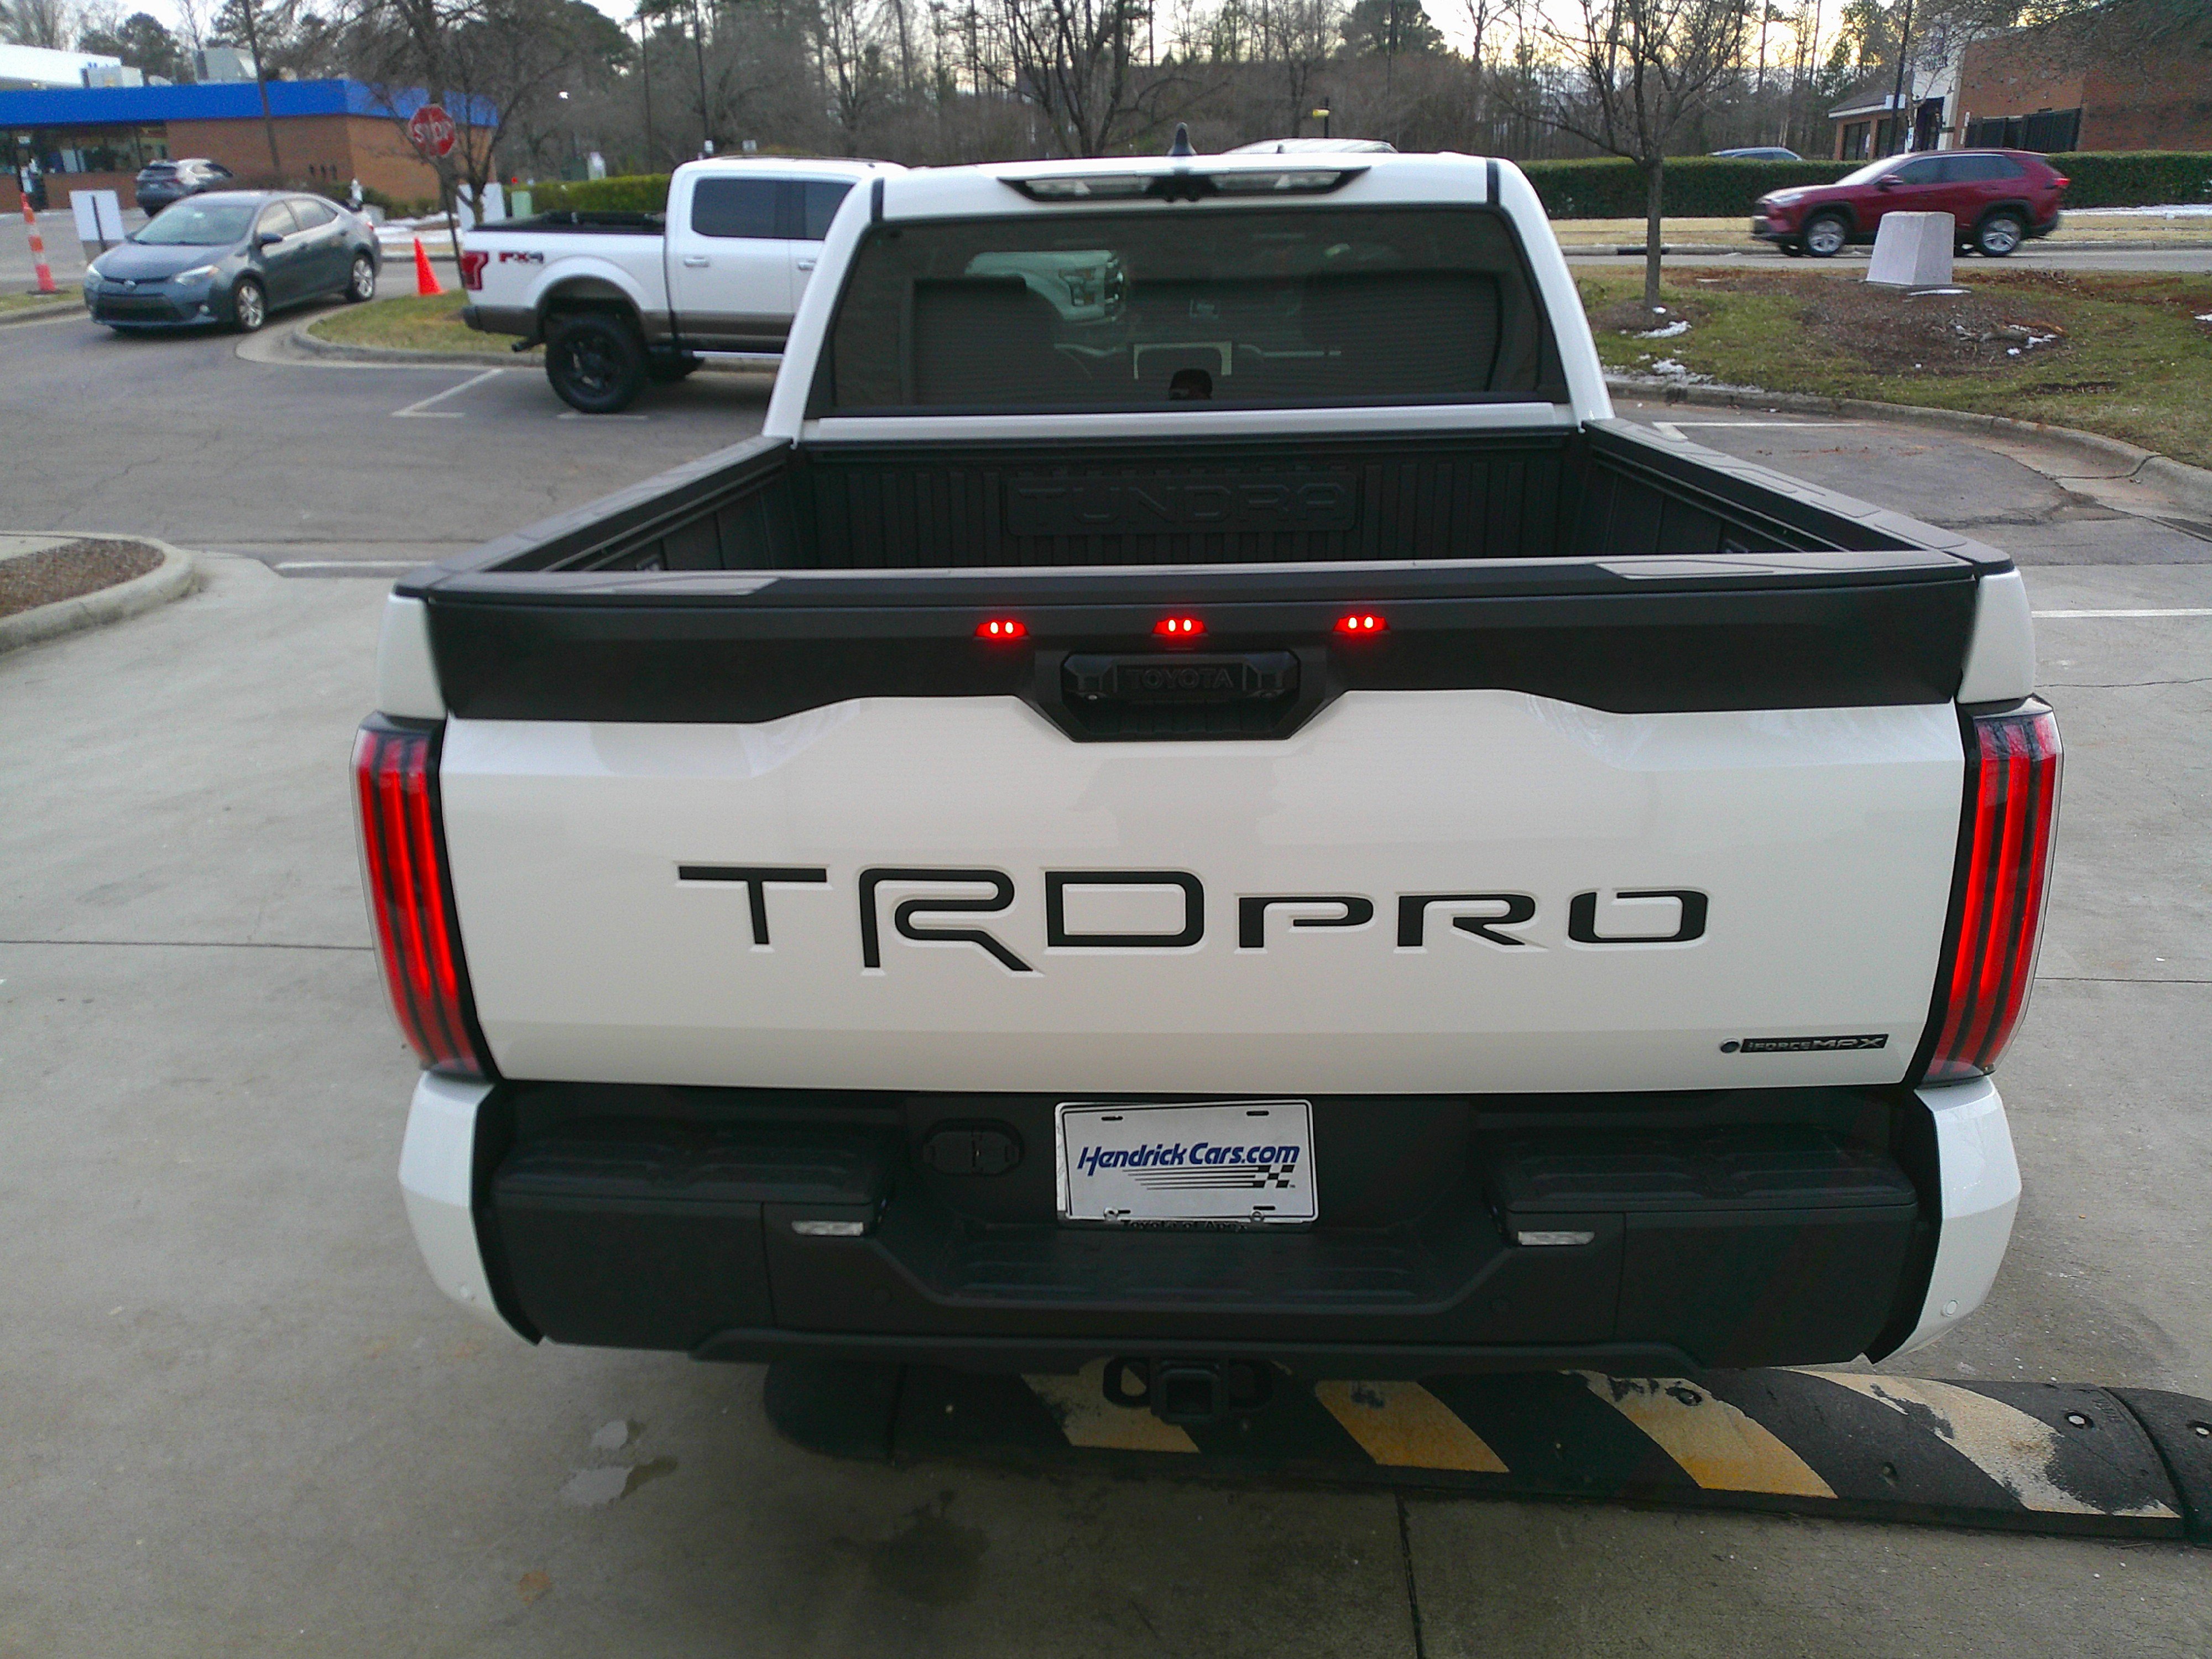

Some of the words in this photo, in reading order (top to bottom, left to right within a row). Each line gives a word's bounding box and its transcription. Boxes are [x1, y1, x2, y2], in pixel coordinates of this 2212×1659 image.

[499, 252, 544, 263] FX4
[1018, 483, 1348, 525] TUNDRA
[1125, 667, 1234, 689] TOYOTA
